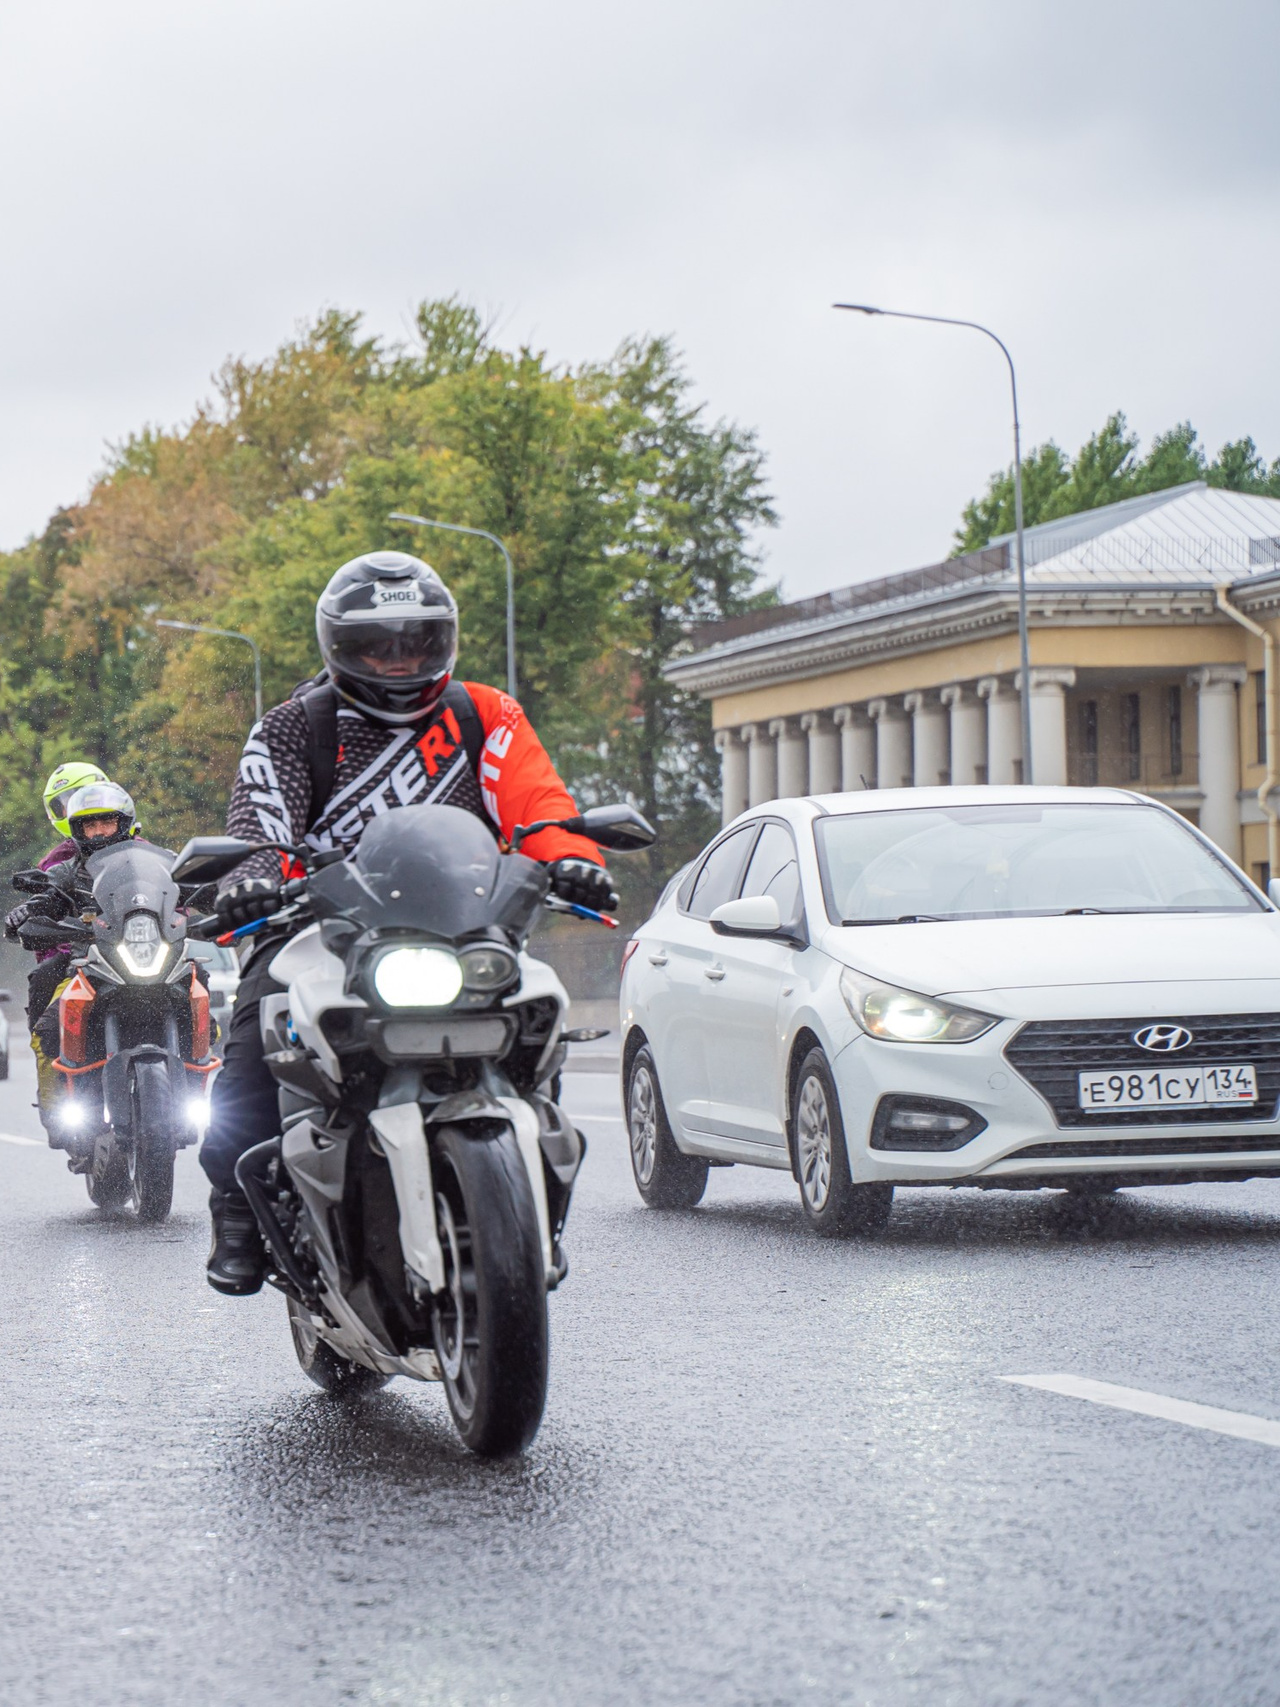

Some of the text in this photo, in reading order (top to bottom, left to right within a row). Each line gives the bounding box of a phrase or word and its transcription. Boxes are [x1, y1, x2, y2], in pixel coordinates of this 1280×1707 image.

[380, 591, 417, 603] SHOEI
[1207, 1068, 1248, 1090] 134
[1216, 1090, 1238, 1099] RUS
